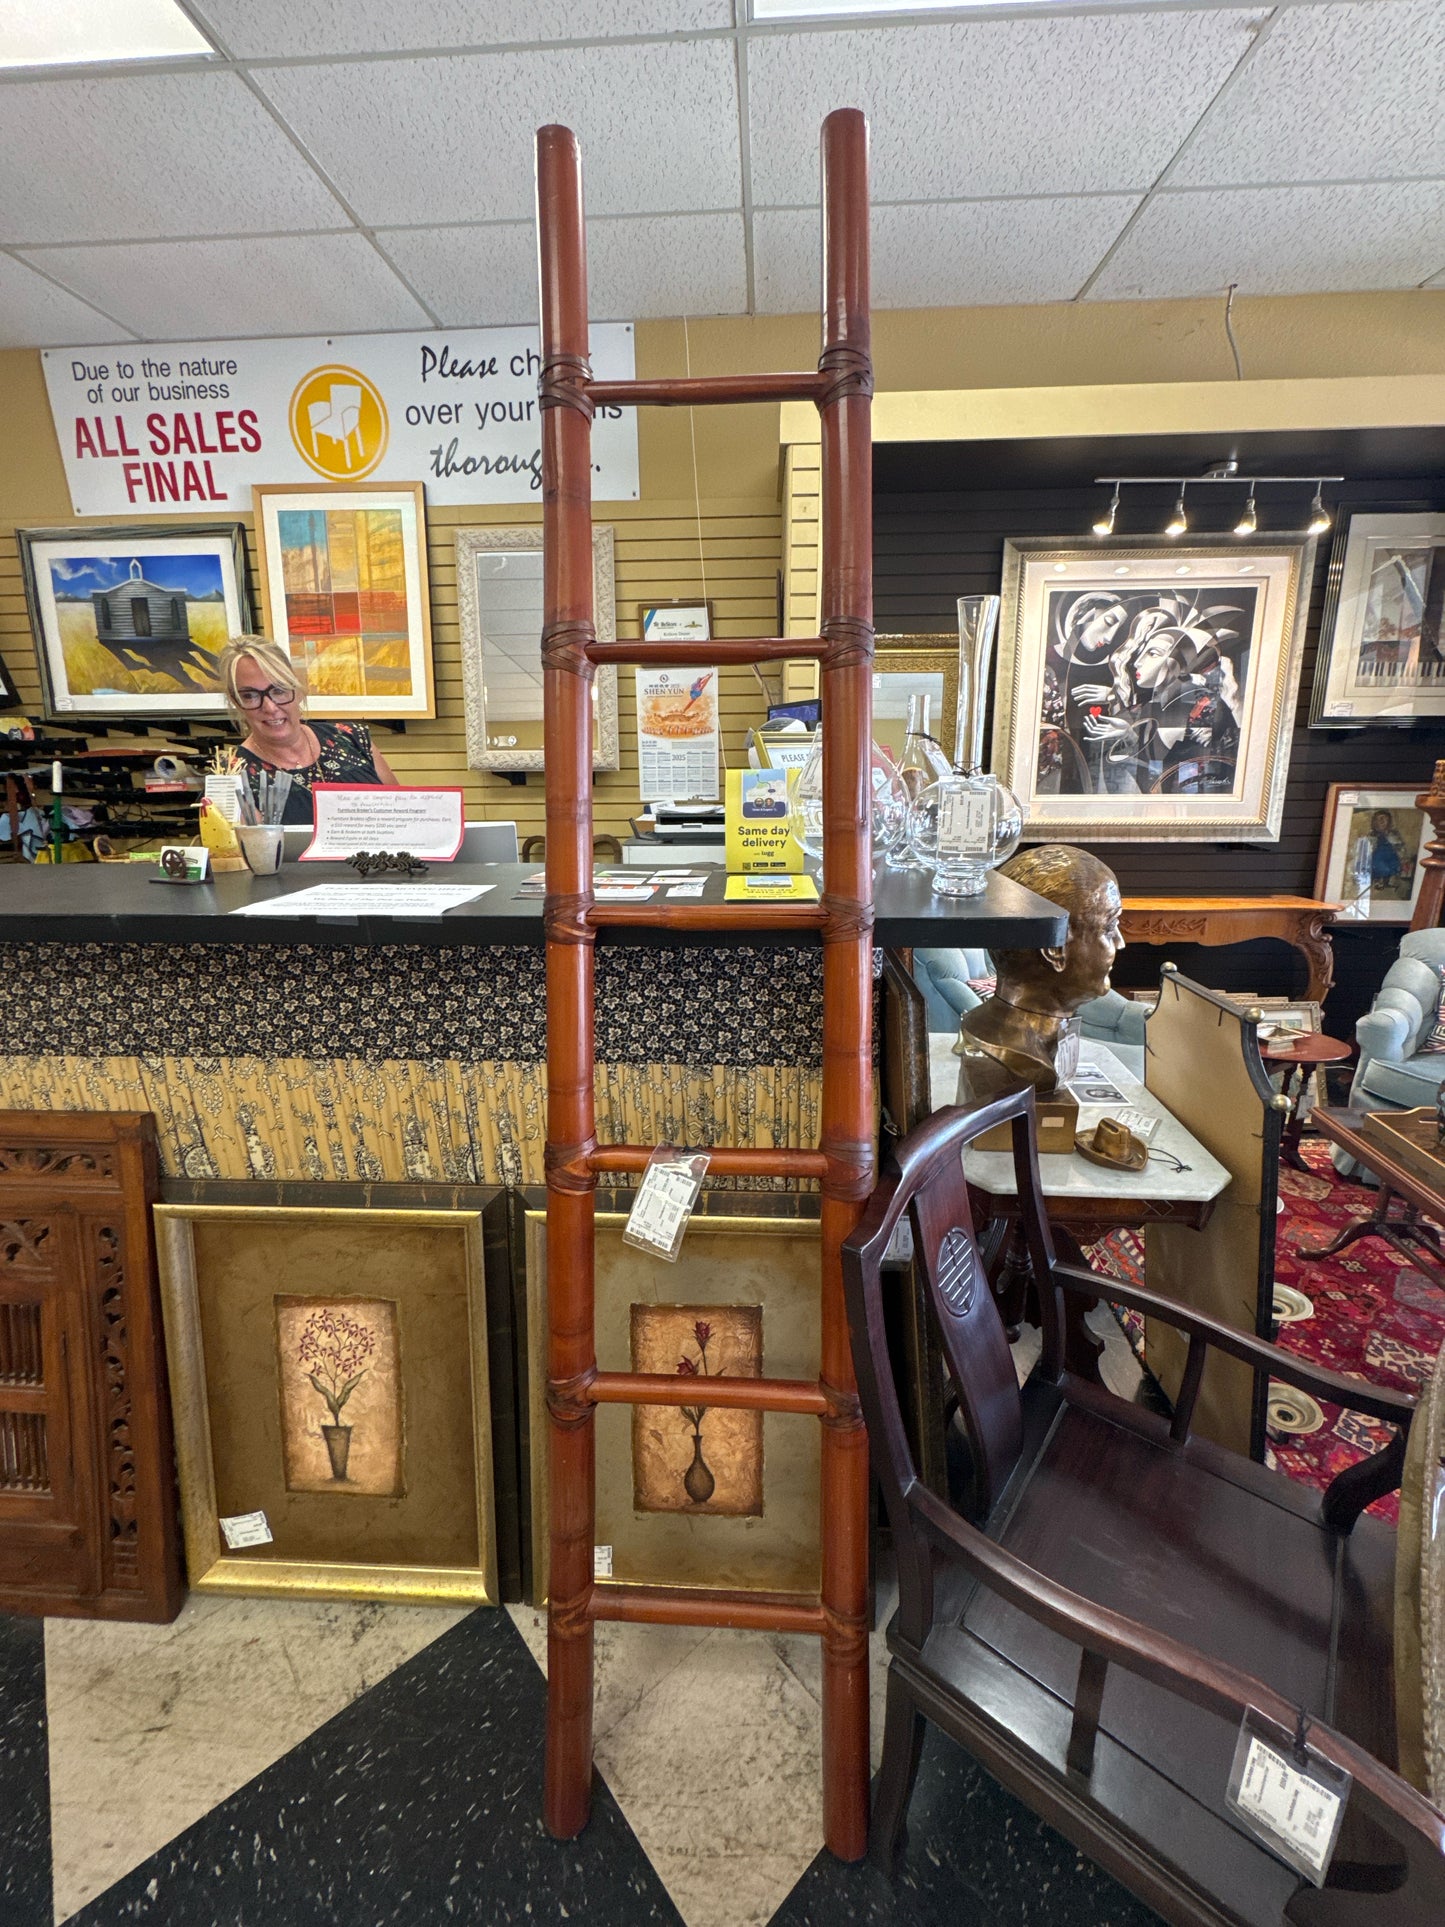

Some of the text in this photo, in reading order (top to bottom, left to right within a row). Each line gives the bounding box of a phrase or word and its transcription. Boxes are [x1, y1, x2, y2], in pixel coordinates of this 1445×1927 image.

[71, 357, 238, 381] Due to the nature
[420, 345, 498, 382] Please
[87, 380, 230, 403] of our business
[405, 400, 535, 430] over your
[75, 409, 262, 458] ALL SALES
[122, 460, 228, 503] FINAL
[781, 754, 805, 762] PLEASE
[738, 826, 790, 837] Same day
[742, 838, 787, 848] delivery
